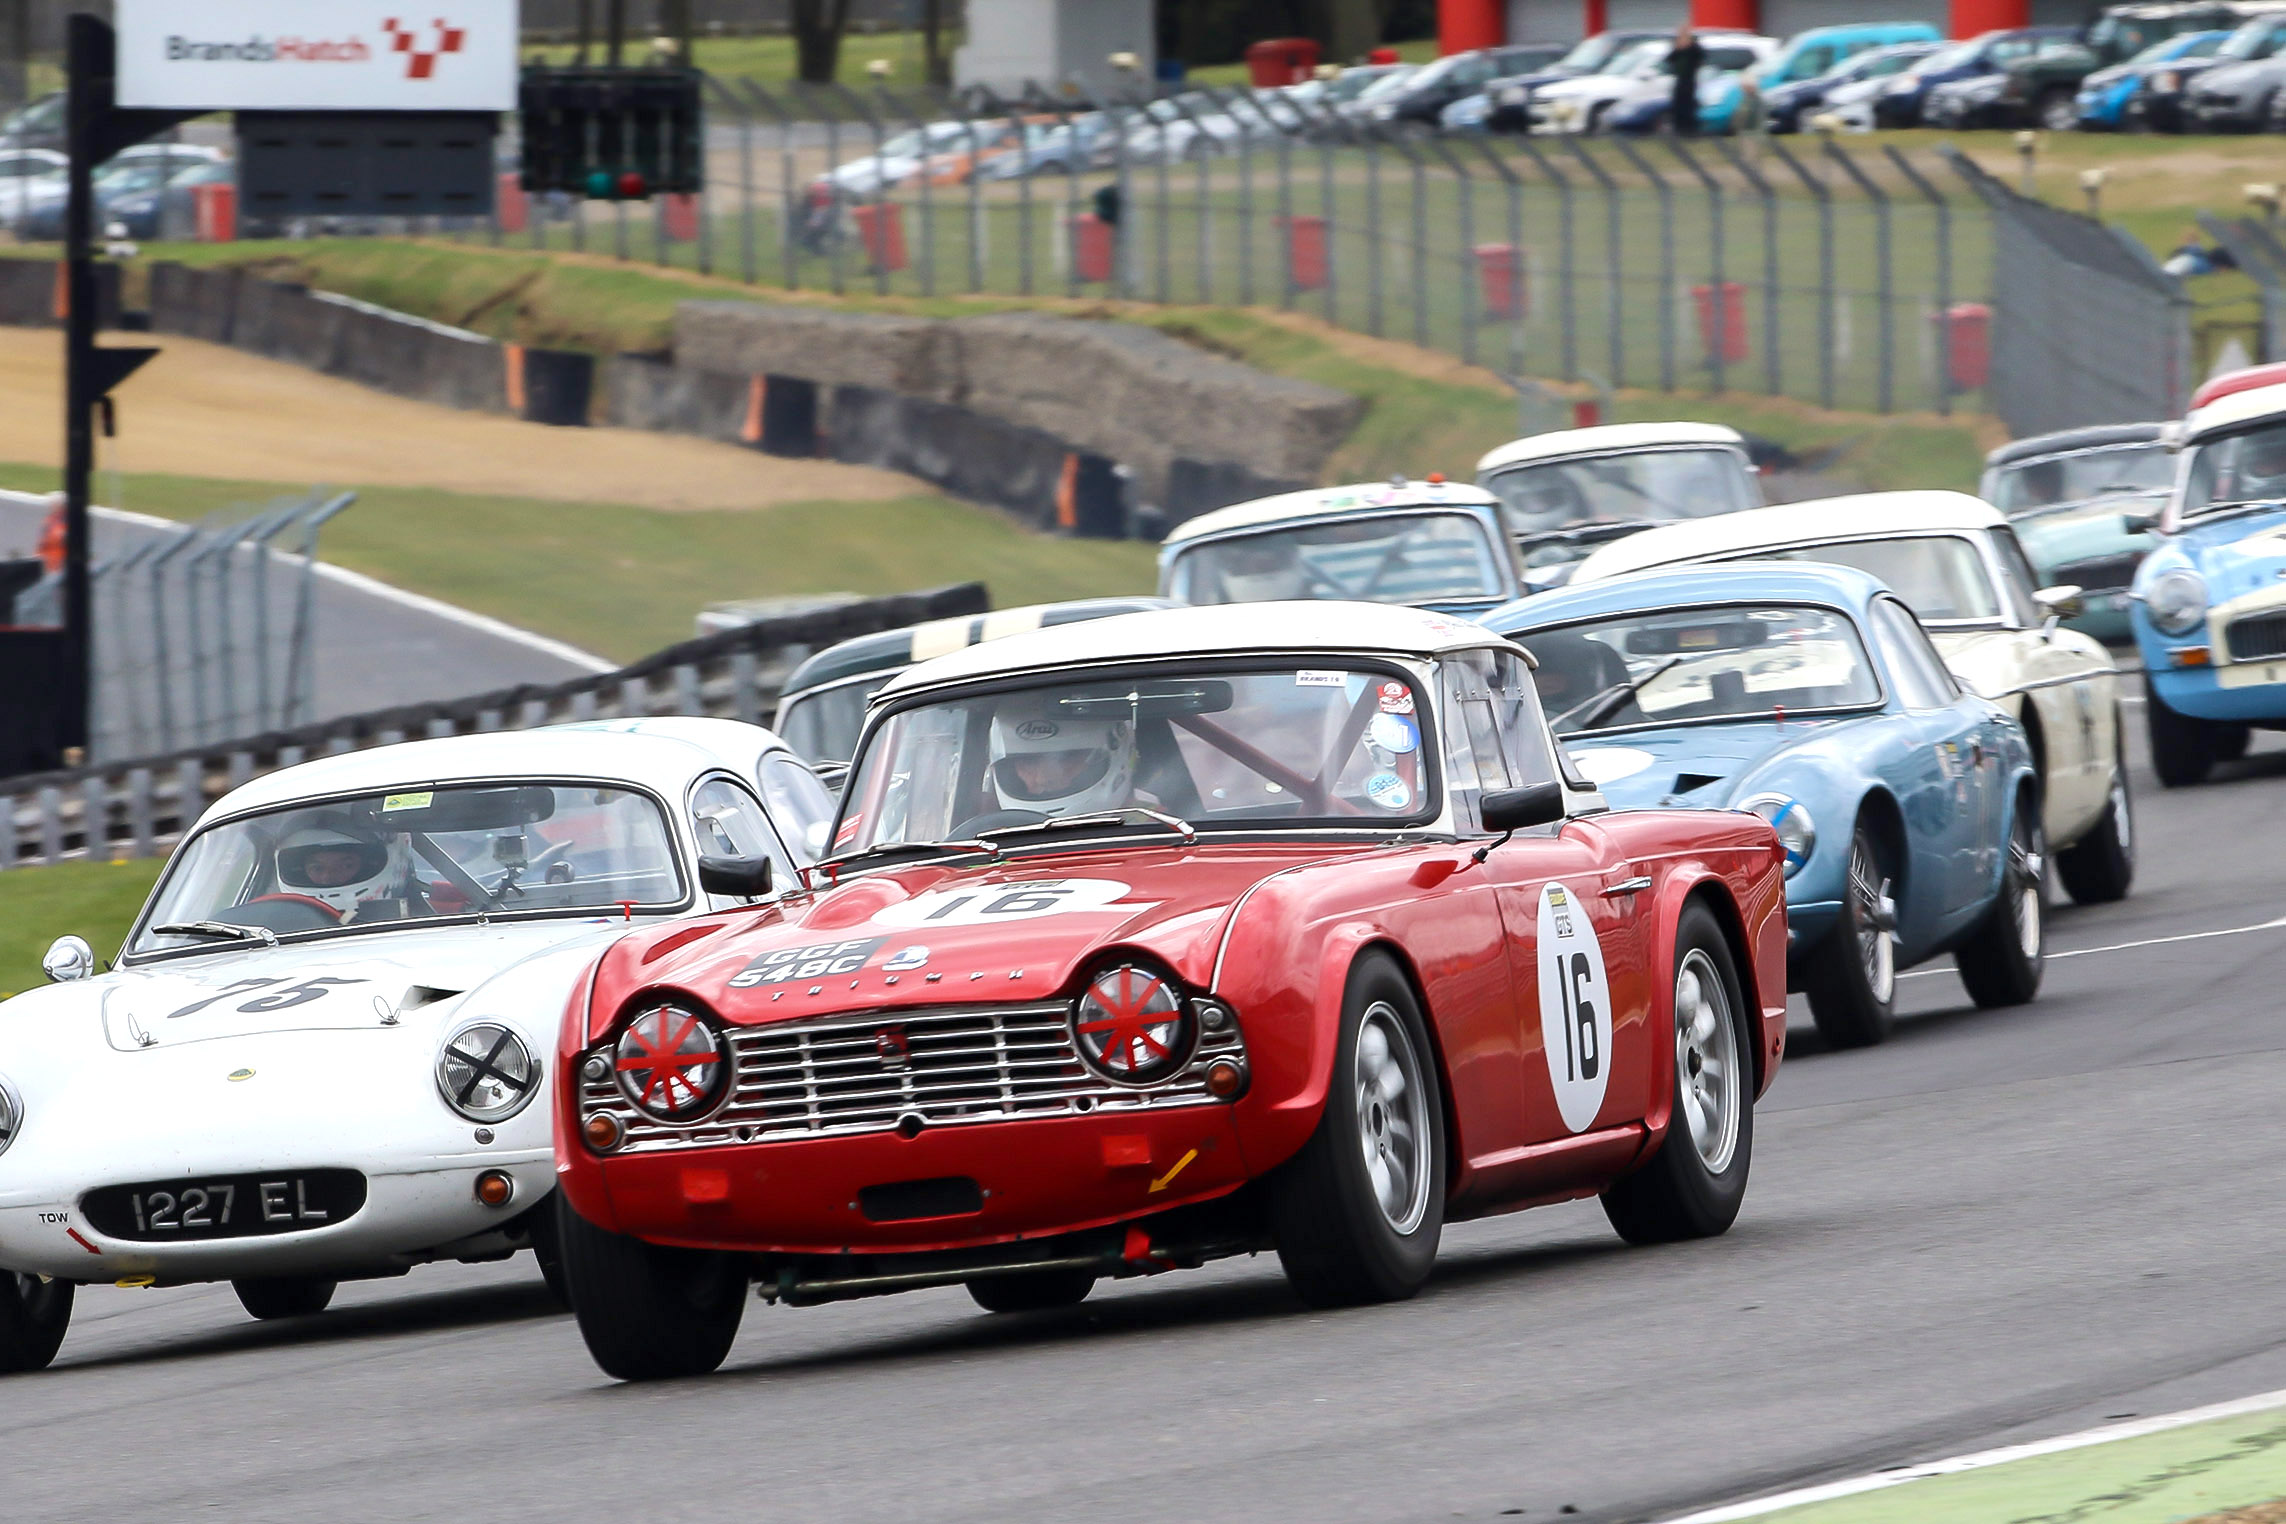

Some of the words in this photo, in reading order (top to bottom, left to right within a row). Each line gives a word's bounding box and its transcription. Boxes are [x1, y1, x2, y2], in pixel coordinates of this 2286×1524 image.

[167, 35, 371, 61] BrandsHatch
[925, 889, 1075, 920] 16
[763, 938, 873, 965] GGF
[728, 954, 866, 988] 548C
[771, 969, 1024, 1001] TRIUMPH
[167, 977, 373, 1018] 75
[1556, 952, 1599, 1082] 16
[38, 1211, 70, 1225] TOW
[131, 1184, 235, 1232] 1227
[259, 1178, 328, 1222] EL
